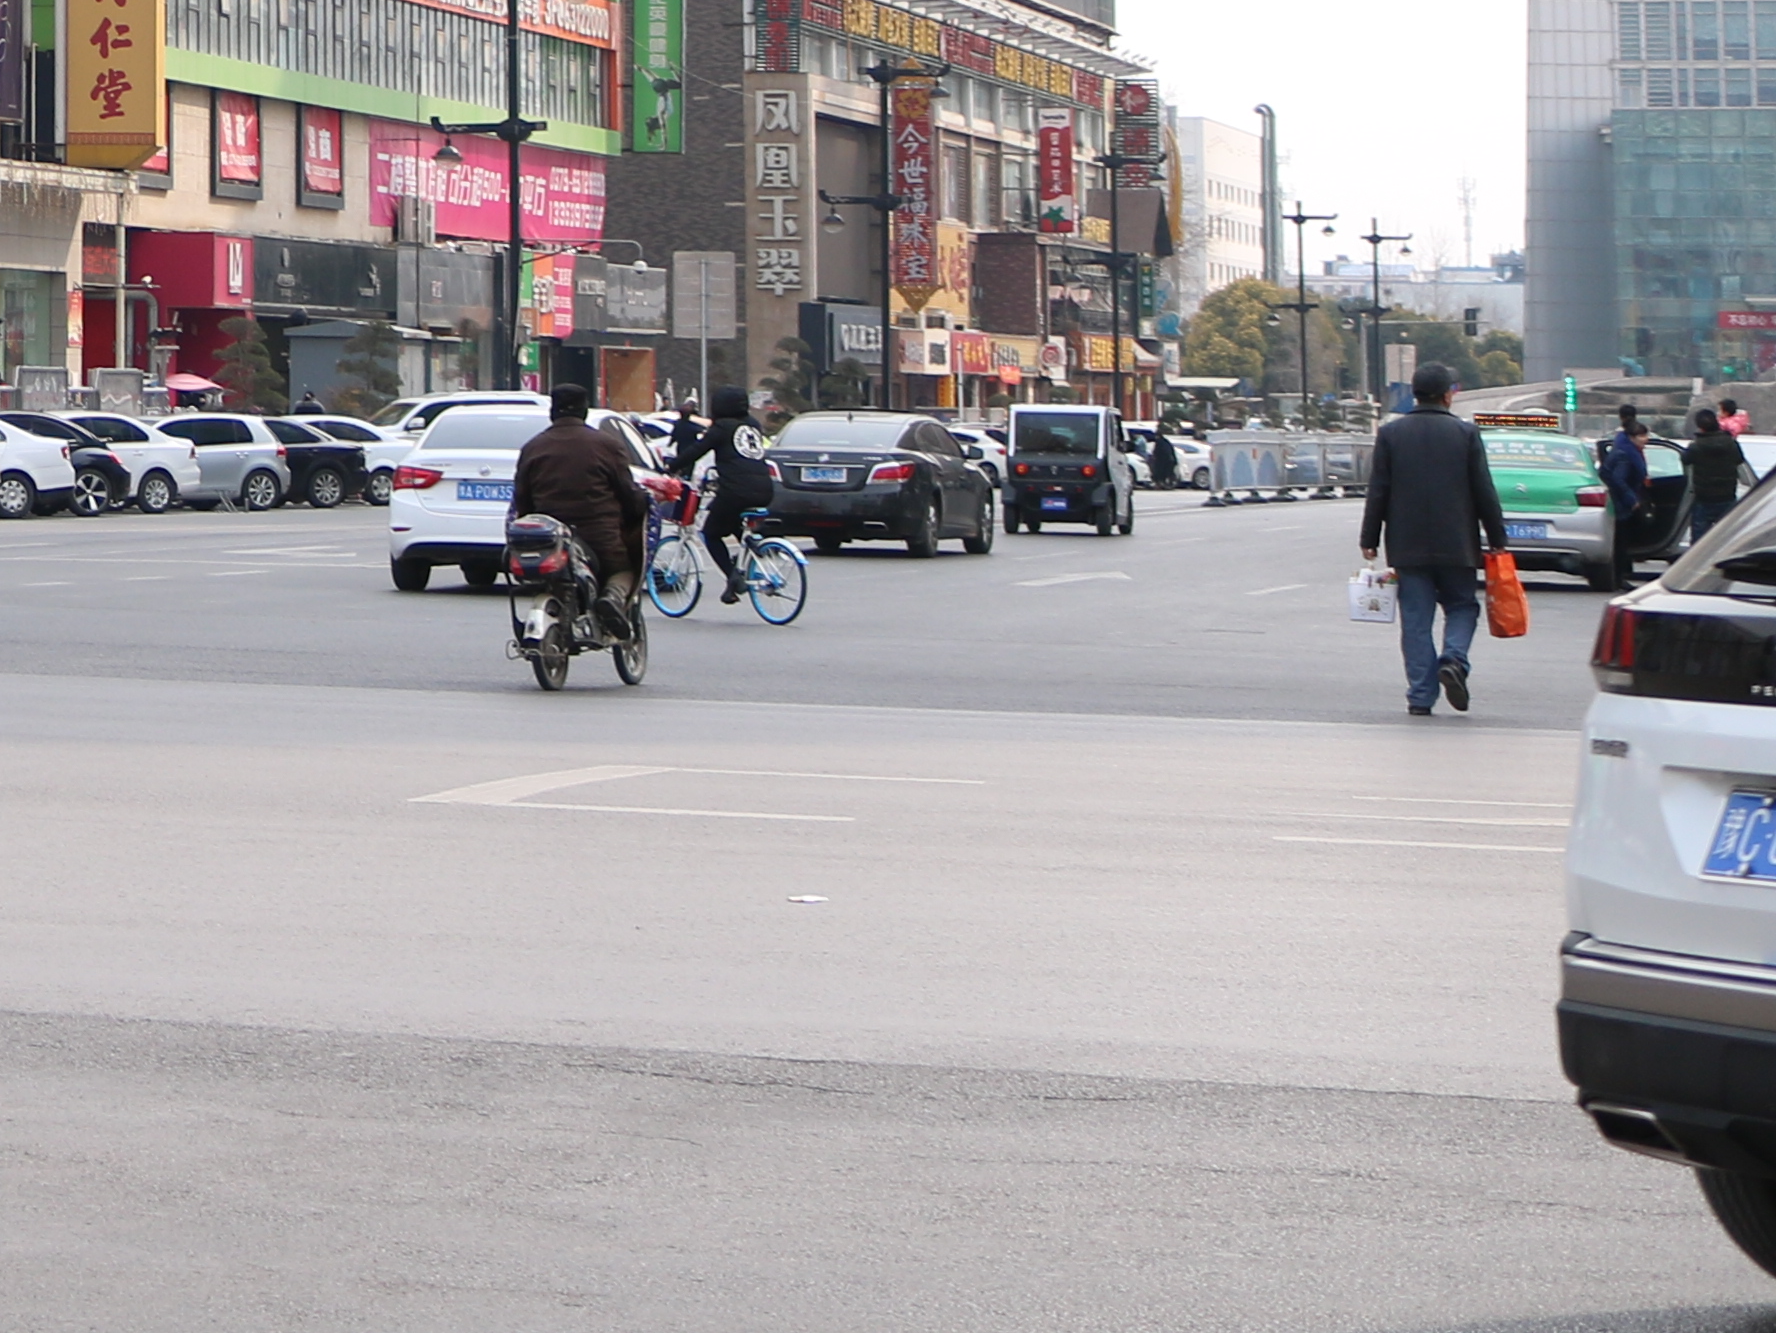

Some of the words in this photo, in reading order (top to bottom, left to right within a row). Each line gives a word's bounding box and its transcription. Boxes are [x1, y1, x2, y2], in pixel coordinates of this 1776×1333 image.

[755, 90, 802, 296] 凤凰玉翠
[898, 124, 928, 280] 今世福珠宝
